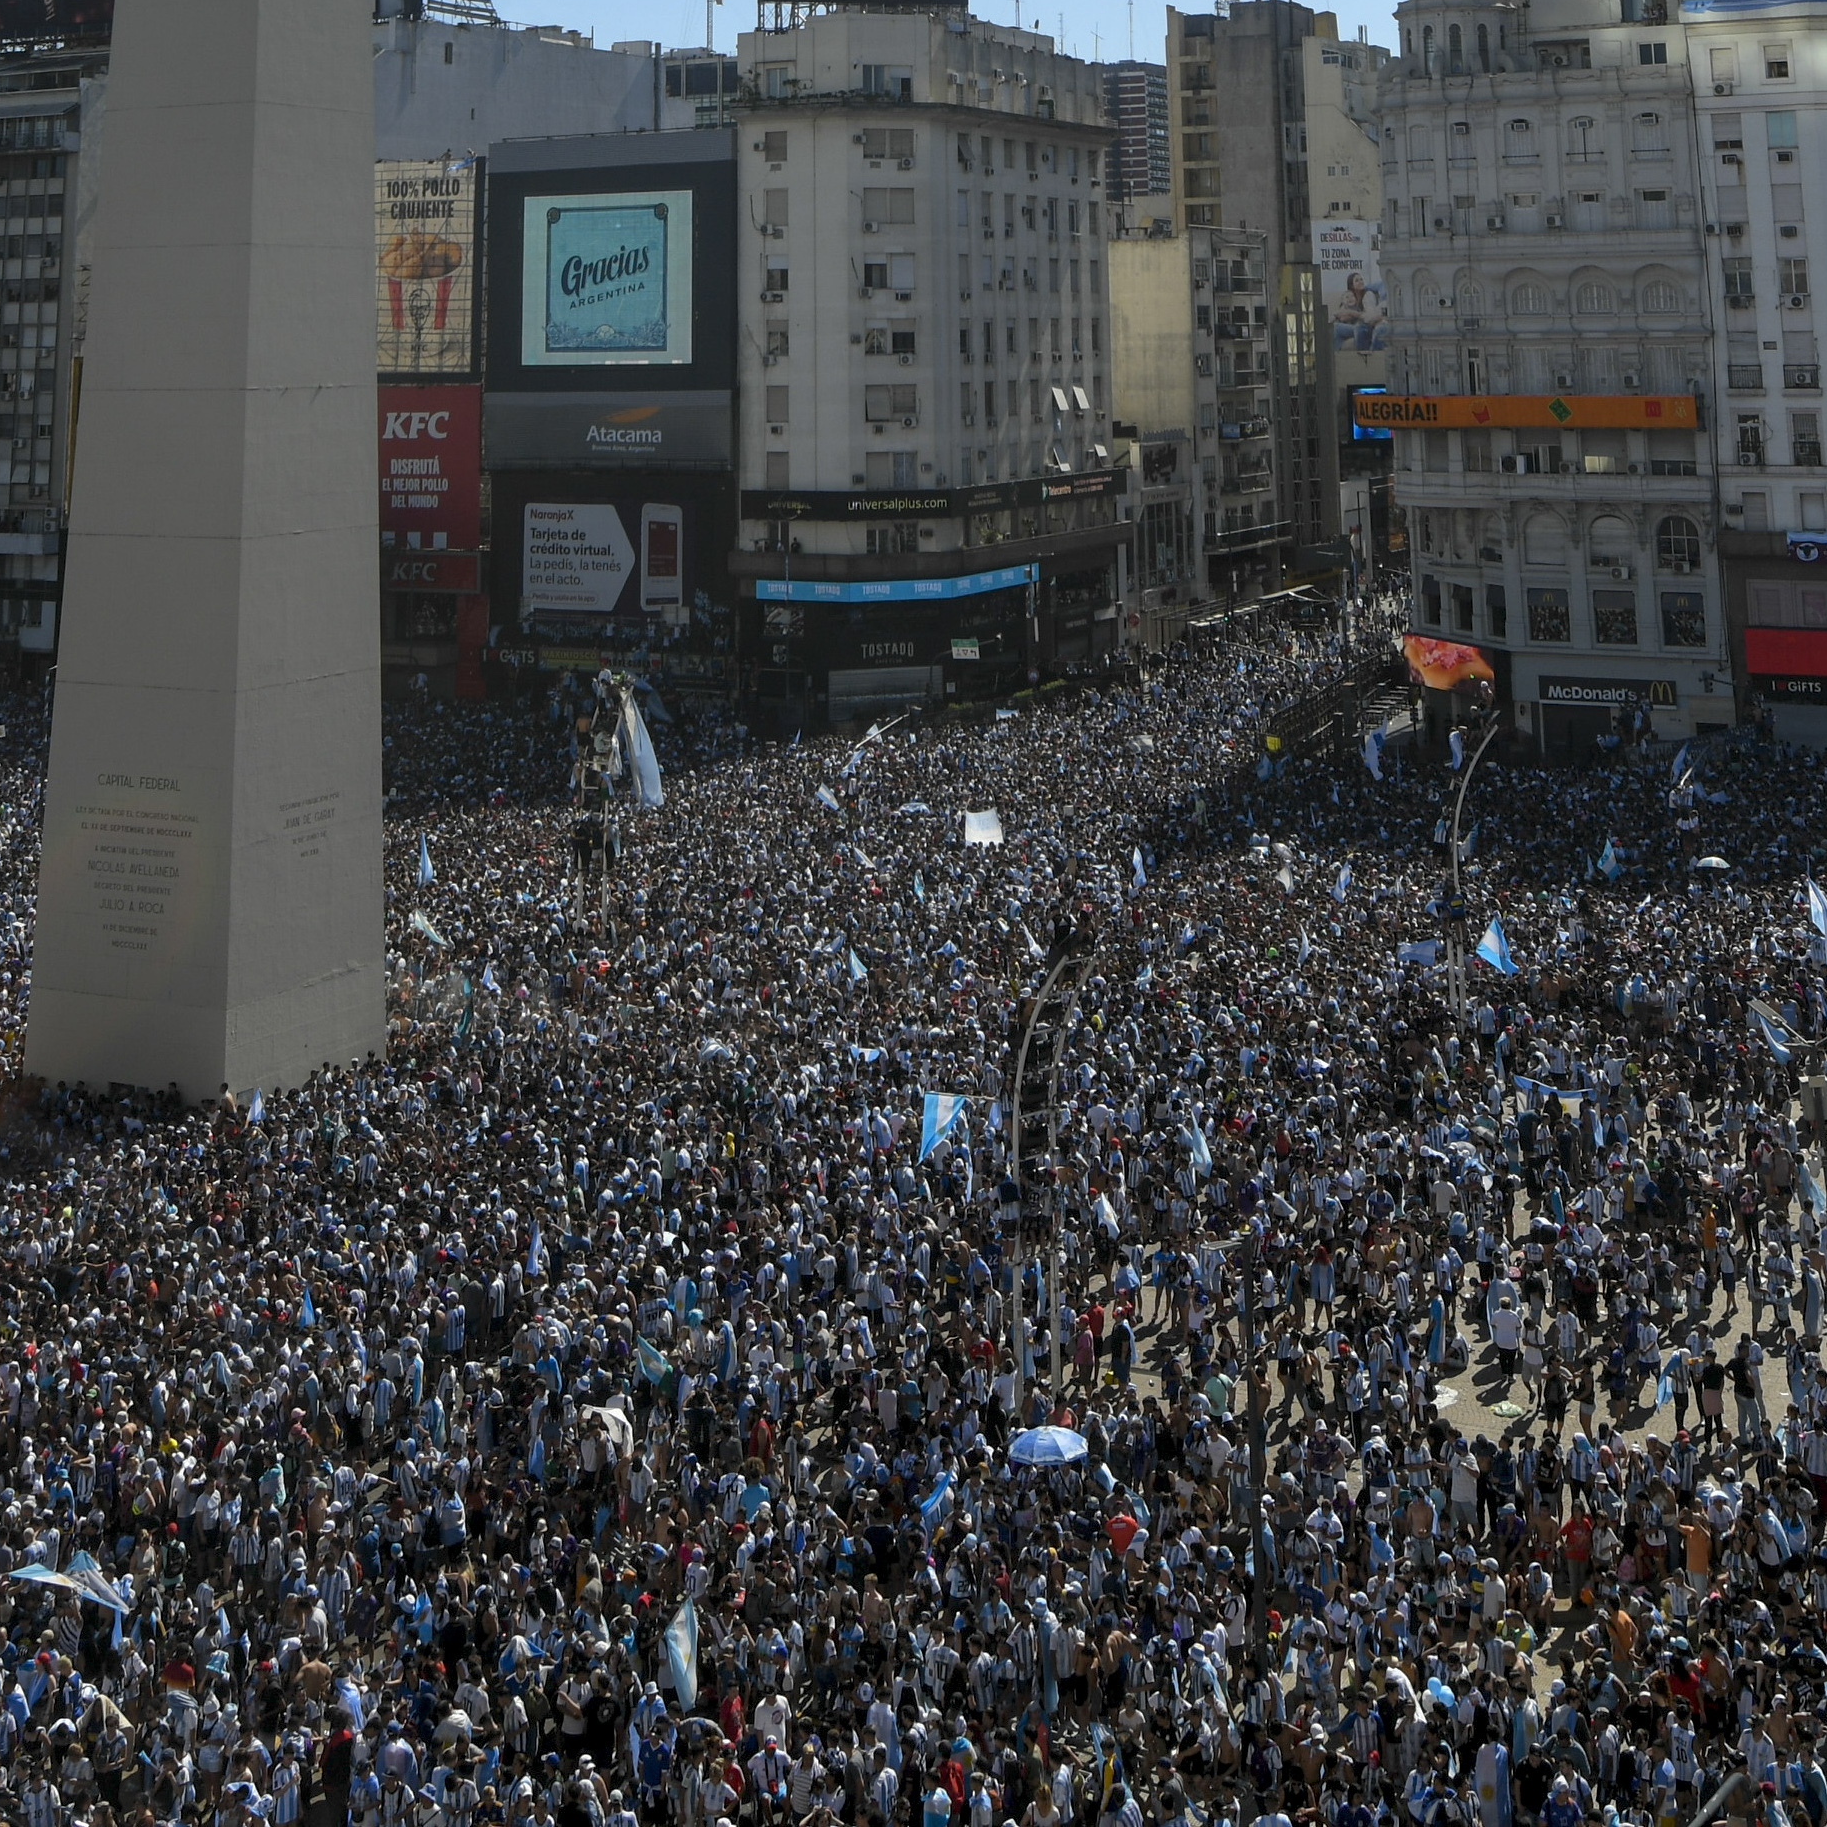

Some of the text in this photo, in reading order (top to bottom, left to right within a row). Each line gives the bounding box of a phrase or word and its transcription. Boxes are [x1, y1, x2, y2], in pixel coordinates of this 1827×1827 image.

[386, 179, 460, 198] 100% POLLO
[391, 201, 454, 219] CRUJIENTE
[1320, 233, 1353, 242] DESILLAS
[1321, 248, 1351, 258] TU ZONA
[561, 245, 650, 297] Gracias
[1322, 260, 1363, 270] DE CONFORT
[570, 281, 646, 310] ARGENTINA
[1357, 397, 1438, 422] ALEGRÍA!!
[382, 411, 449, 440] KFC
[586, 425, 662, 443] Atacama
[390, 455, 440, 475] DISFRUTÁ
[382, 478, 448, 491] EL MEJOR POLLO
[391, 495, 438, 508] DEL MUNDO
[847, 498, 947, 512] universalplus.com
[530, 509, 573, 522] NaranjaX
[530, 527, 586, 542] Tarjeta de
[530, 543, 614, 556] crédito virtual.
[392, 562, 437, 582] KFC
[530, 557, 621, 572] La pedís, la tenés
[530, 573, 583, 585] en el acto.
[767, 583, 792, 594] TOSTADO
[815, 584, 840, 595] TOSTADO
[863, 584, 890, 595] TOSTADO
[914, 582, 942, 594] TOSTADO
[861, 642, 914, 659] TOSTADO
[1548, 685, 1637, 701] McDonald's
[1772, 681, 1775, 691] I
[98, 773, 181, 792] CAPITAL FEDERAL
[100, 823, 108, 831] DE
[147, 827, 154, 835] DE
[88, 859, 179, 878] NICOLAS AVELLANEDA
[94, 881, 171, 896] DECRETO DEL PRESIDENTE
[99, 899, 124, 910] JULIO
[139, 902, 164, 914] ROCA
[935, 1661, 948, 1682] 10
[1676, 1746, 1687, 1763] 10
